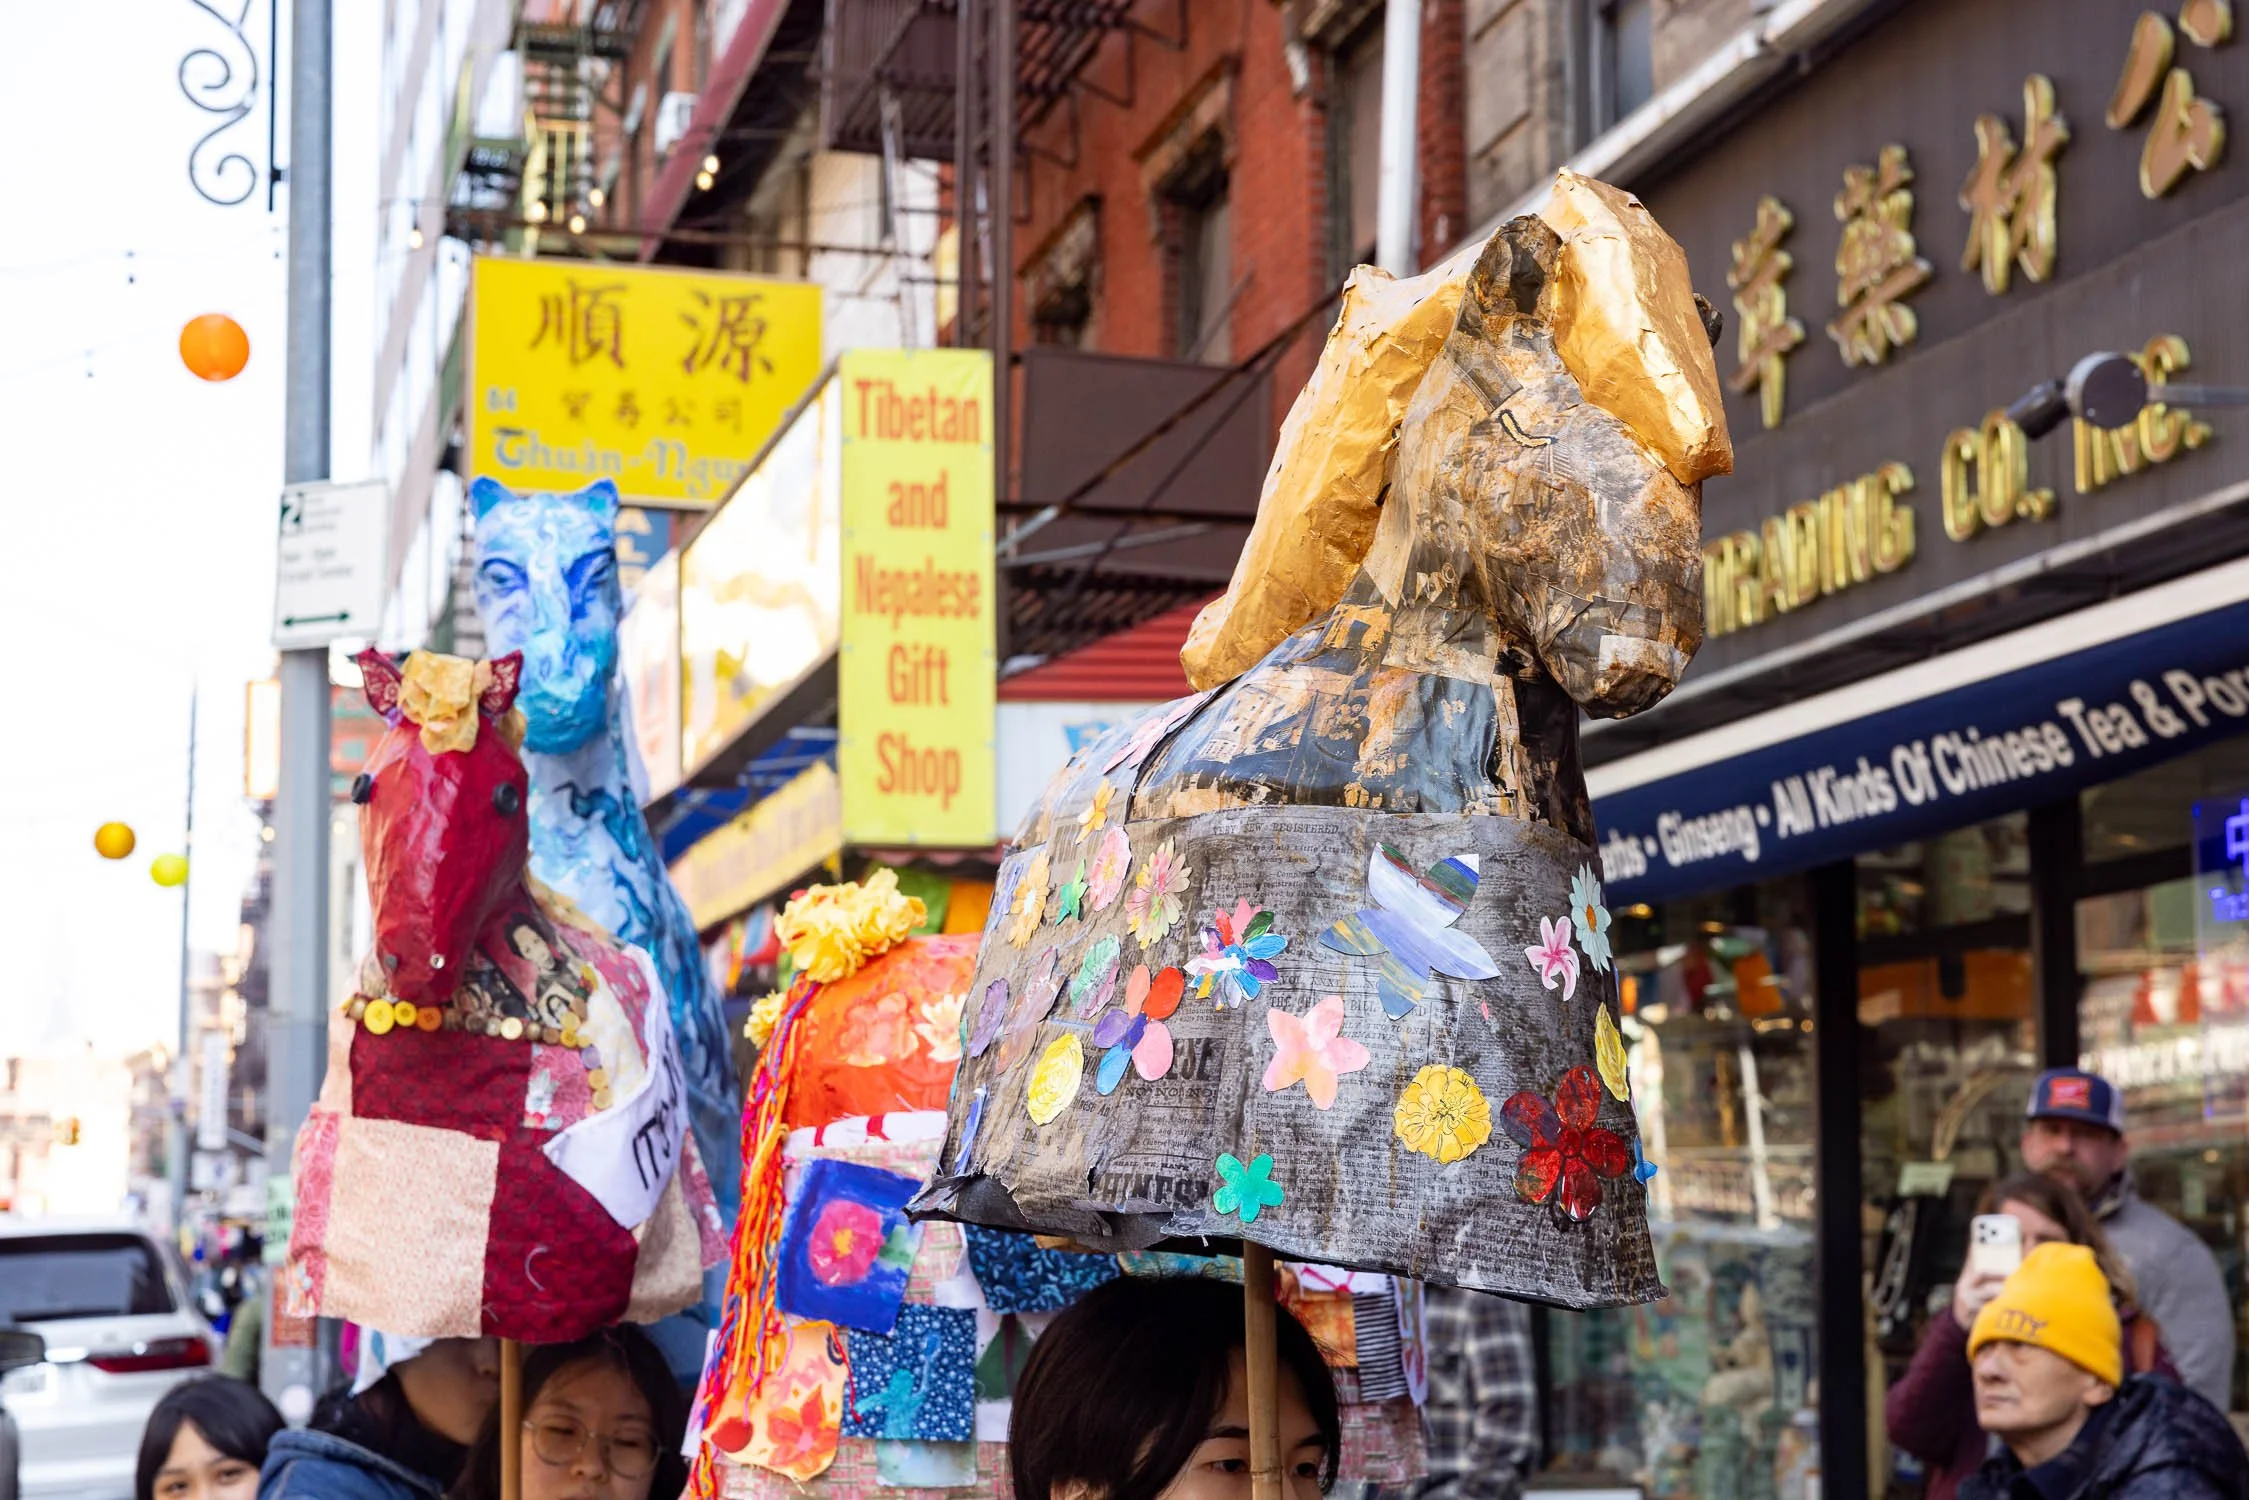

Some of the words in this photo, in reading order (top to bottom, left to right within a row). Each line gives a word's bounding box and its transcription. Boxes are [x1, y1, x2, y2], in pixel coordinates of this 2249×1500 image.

[856, 379, 981, 443] Tibetan
[888, 467, 950, 529] and
[855, 554, 982, 631] Nepalese
[889, 643, 950, 706] Gift
[877, 732, 962, 811] Shop
[1657, 805, 1760, 867] Ginseng
[1771, 775, 1814, 840] All
[1815, 757, 1897, 828] Kinds
[1891, 740, 1937, 806] Of
[1931, 726, 2075, 796] Chinese
[2056, 697, 2149, 758] Tea
[2130, 679, 2188, 738] &
